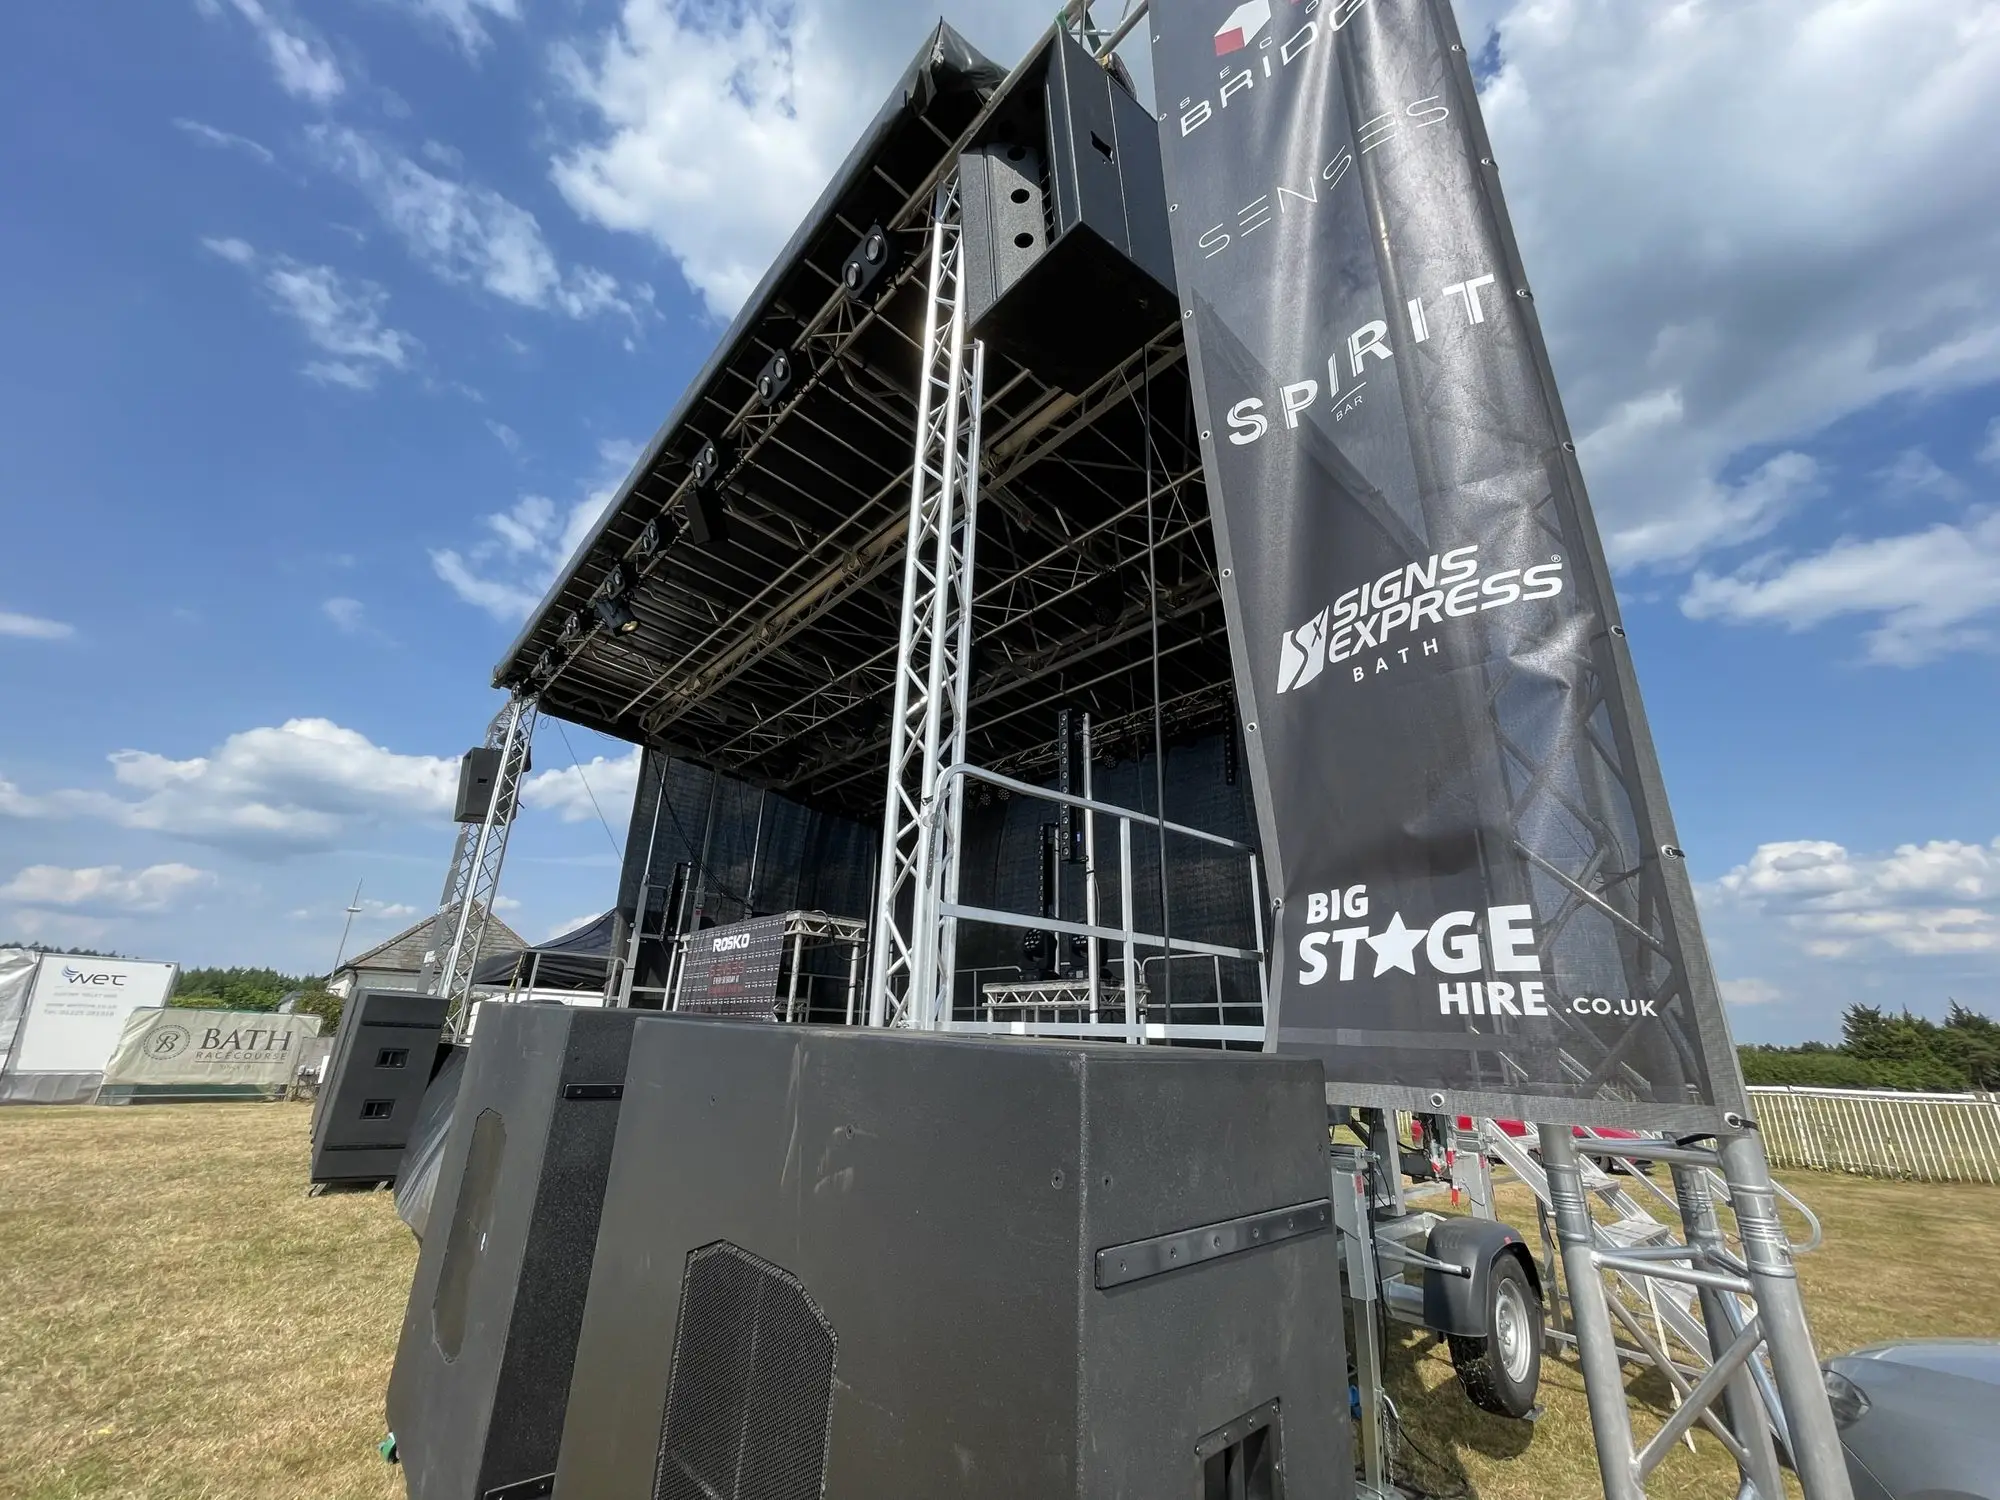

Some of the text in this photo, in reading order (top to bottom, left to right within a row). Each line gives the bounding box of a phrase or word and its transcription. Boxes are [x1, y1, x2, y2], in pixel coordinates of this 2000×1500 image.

[1198, 94, 1449, 259] SENSES
[1226, 272, 1496, 446] SPIRIT
[1335, 394, 1364, 422] BAR
[1332, 544, 1479, 631] SIGNS
[1352, 637, 1439, 683] BATH
[1306, 884, 1370, 924] BIG
[712, 933, 750, 952] ROSKO
[1438, 981, 1549, 1017] HIRE
[195, 1051, 288, 1061] RACECOURSE
[199, 1028, 293, 1051] BATH
